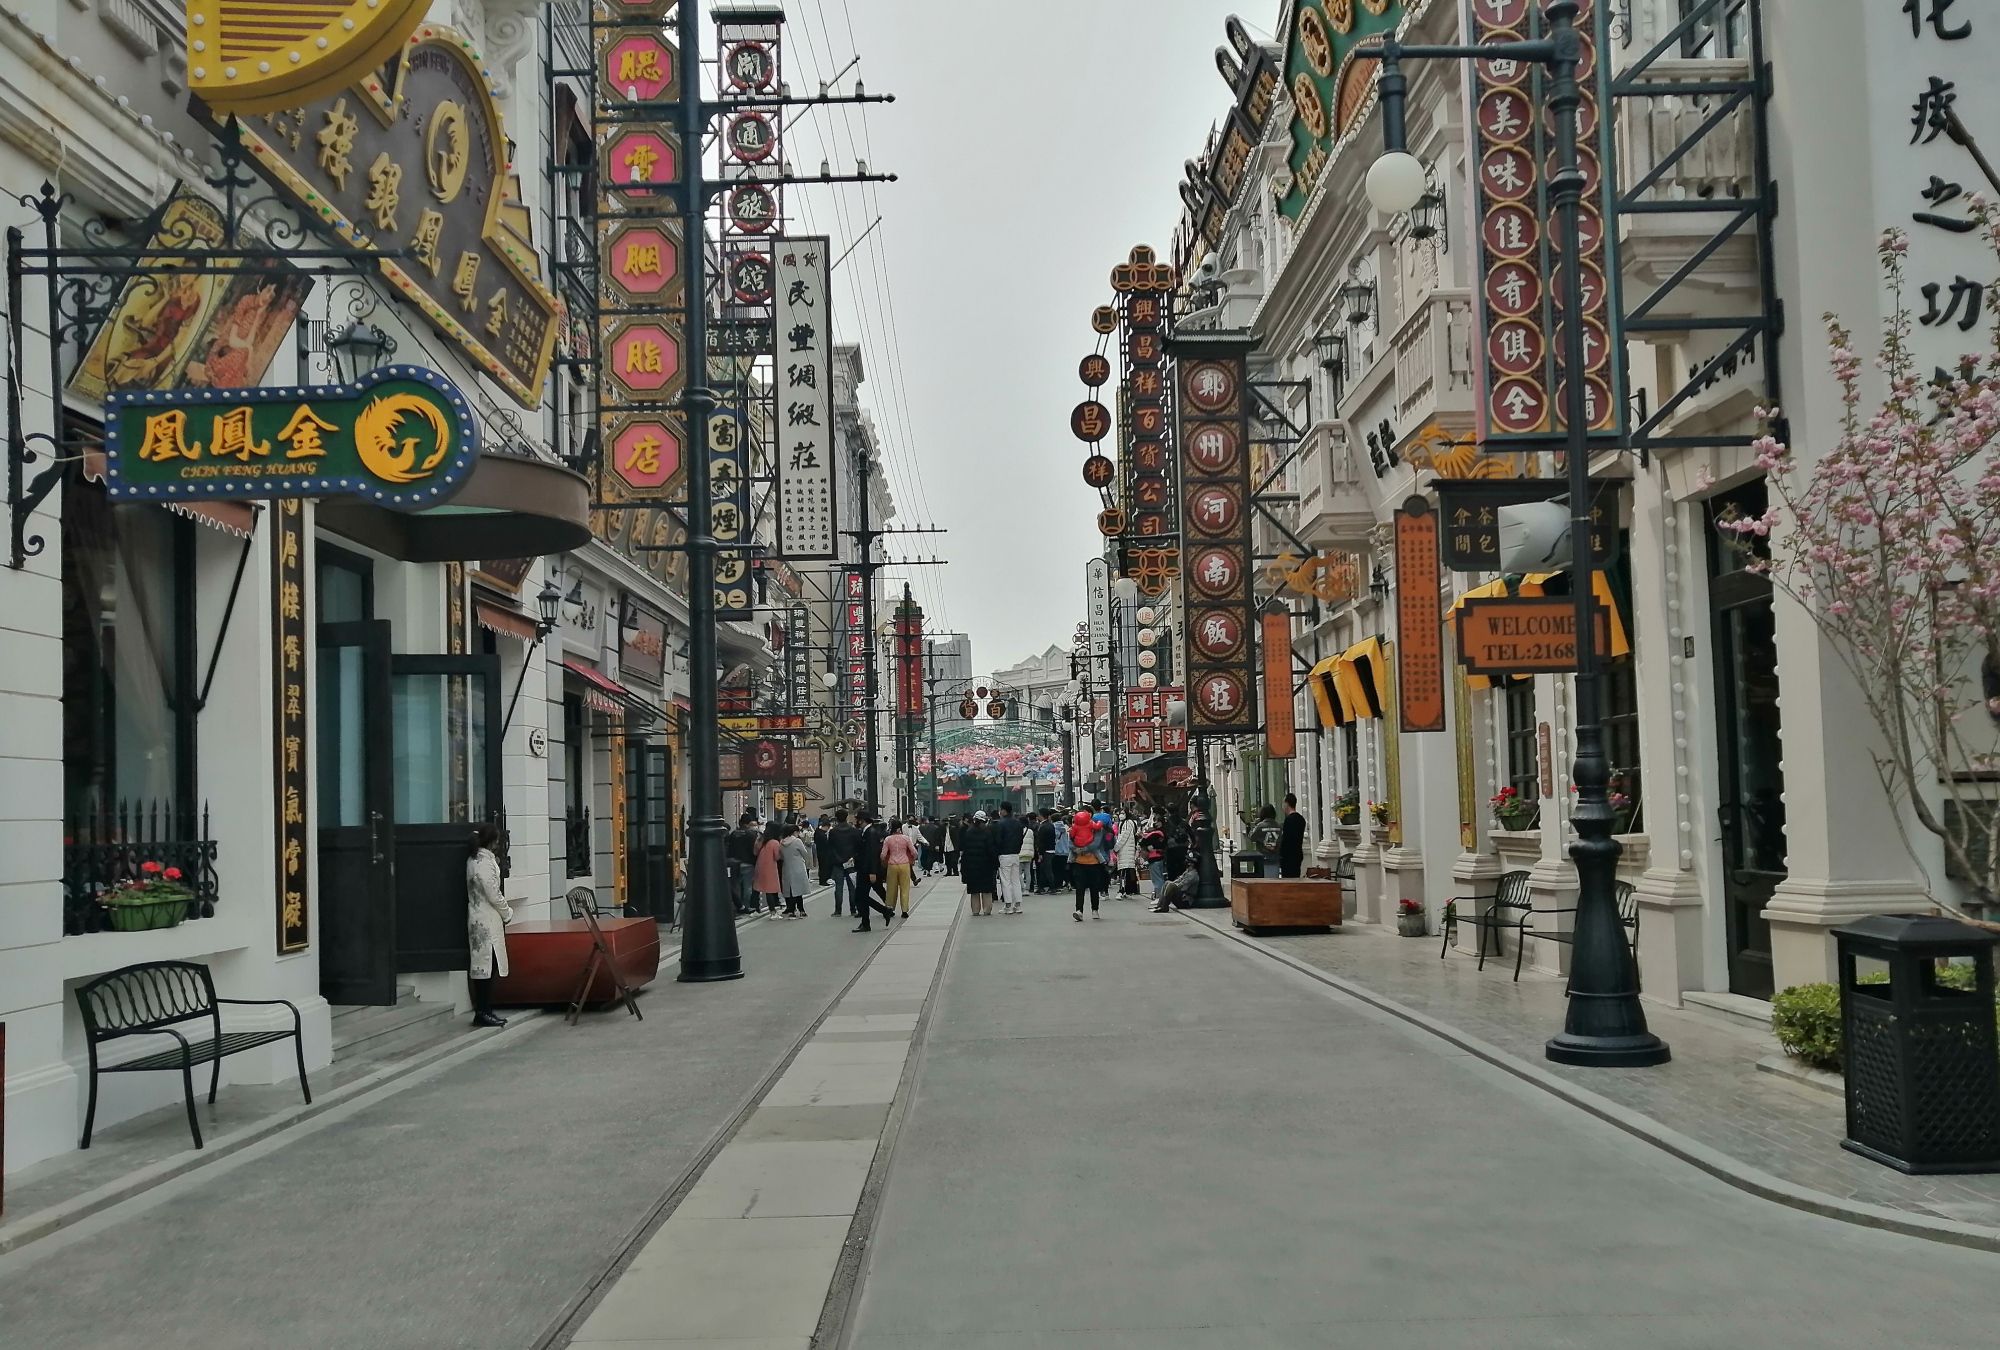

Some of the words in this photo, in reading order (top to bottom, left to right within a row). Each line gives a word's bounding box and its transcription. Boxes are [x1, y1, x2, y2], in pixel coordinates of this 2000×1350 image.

[1080, 360, 1108, 480] 興昌祥
[181, 464, 219, 478] CHIN
[223, 463, 262, 477] FENG
[265, 461, 316, 476] HUANG
[1487, 616, 1576, 636] WELCOME
